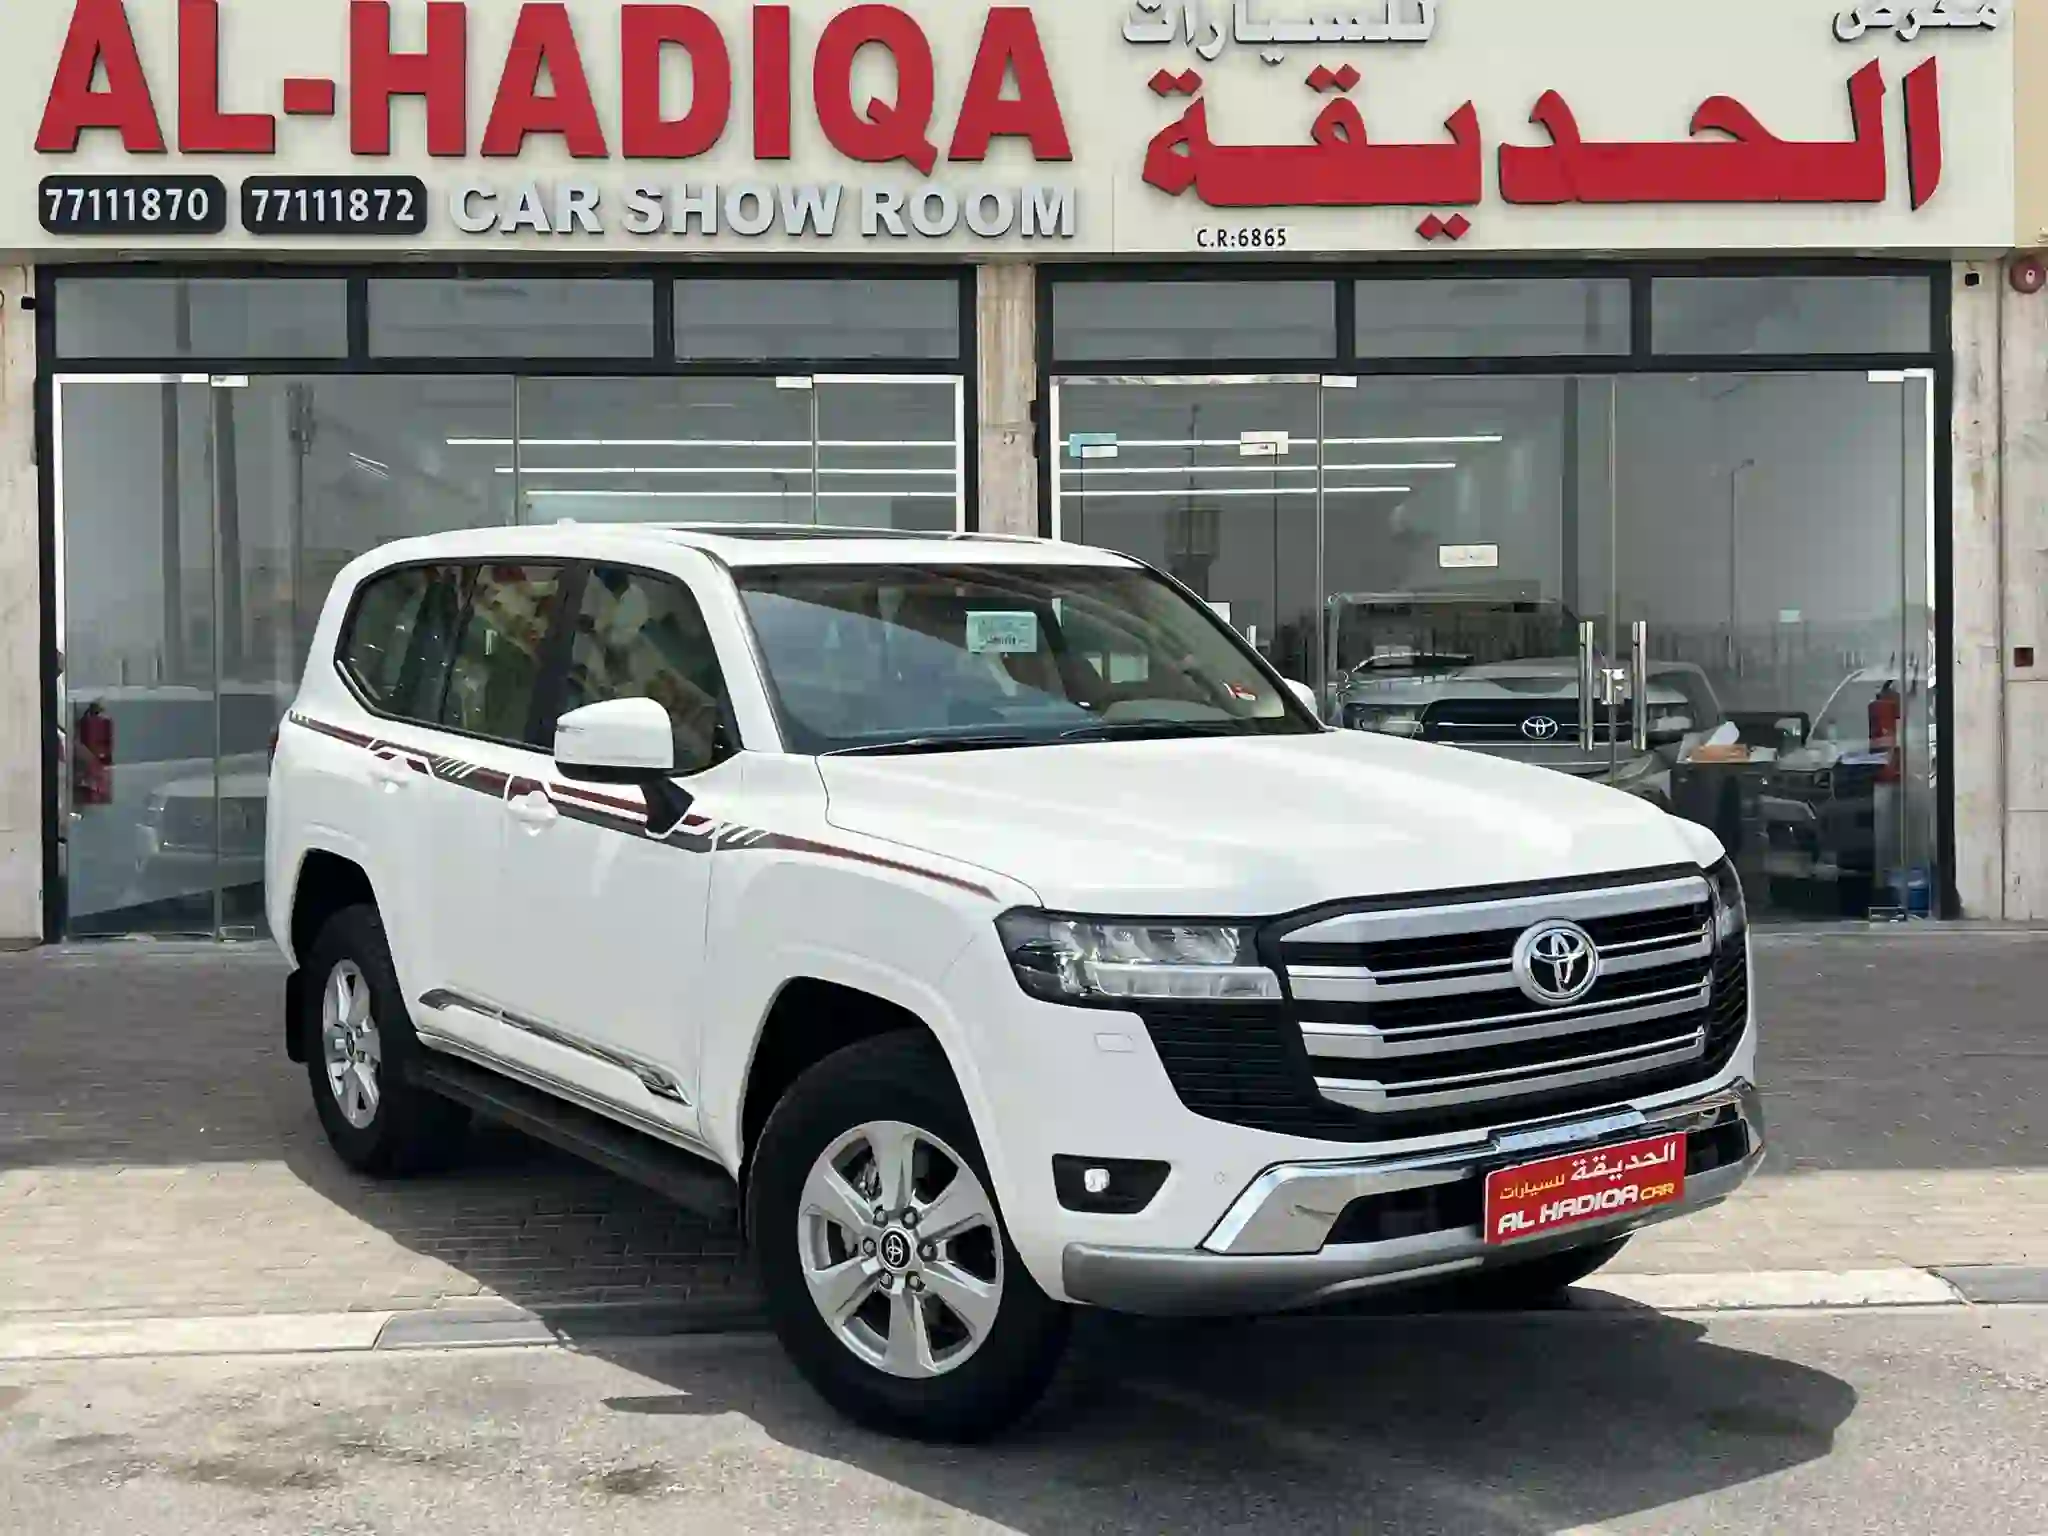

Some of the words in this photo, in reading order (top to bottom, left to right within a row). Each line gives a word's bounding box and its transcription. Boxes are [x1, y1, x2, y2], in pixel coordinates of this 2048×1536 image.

[34, 0, 1073, 176] AL-HADIQA
[1142, 56, 1942, 240] الحديقة
[45, 188, 209, 222] 77111870
[250, 188, 414, 222] 77111872
[449, 182, 604, 234] CAR
[621, 182, 842, 236] SHOW
[861, 185, 1075, 237] ROOM
[1196, 228, 1287, 247] C.R:6865
[1570, 1141, 1676, 1181] الحديقة
[1499, 1173, 1565, 1200] للسيارات
[1497, 1211, 1535, 1234] AL
[1539, 1184, 1639, 1224] HADIQA
[1640, 1182, 1675, 1201] CAR
